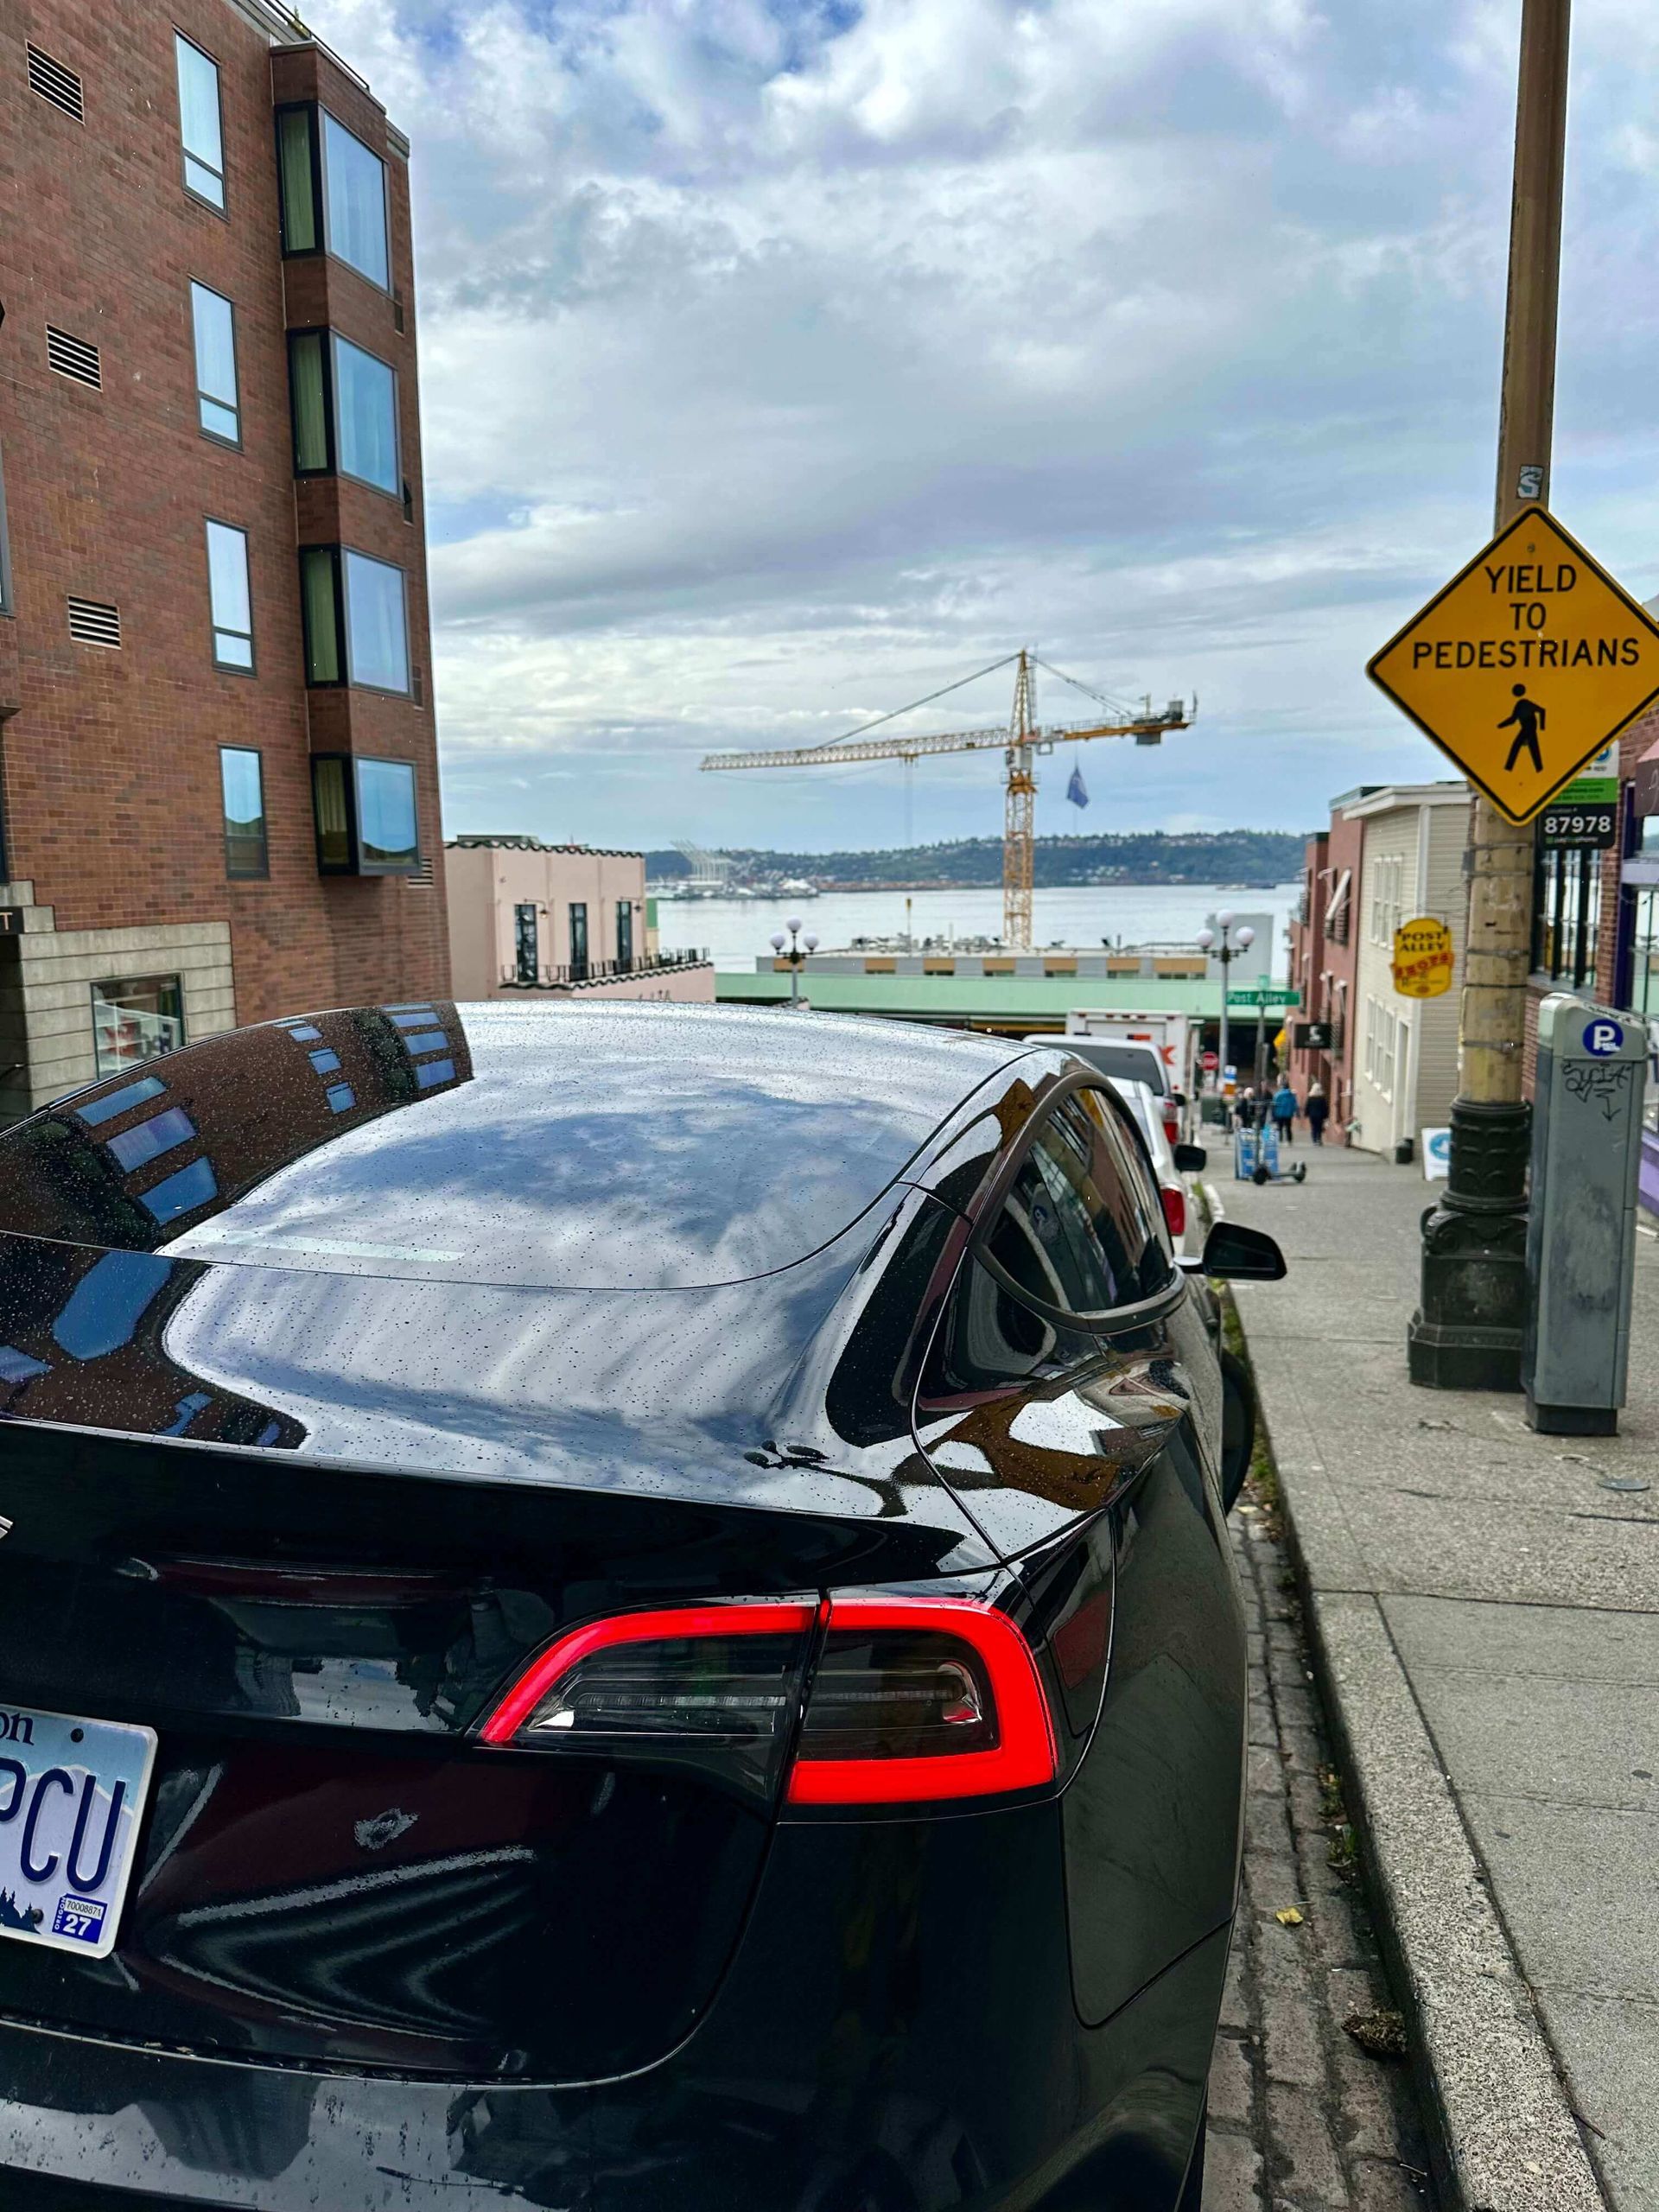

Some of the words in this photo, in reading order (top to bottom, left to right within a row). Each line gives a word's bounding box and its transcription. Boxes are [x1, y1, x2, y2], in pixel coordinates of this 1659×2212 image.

[1484, 564, 1577, 594] YIELD
[1510, 602, 1547, 631] TO
[1413, 638, 1640, 669] PEDESTRIANS
[1545, 816, 1611, 834] 87978
[1400, 942, 1446, 952] ALLEY
[1401, 931, 1445, 943] POST
[1227, 992, 1251, 1003] Post
[1255, 992, 1286, 1005] Alley
[1592, 1026, 1616, 1050] P
[54, 1897, 67, 1930] OREGON
[67, 1900, 101, 1916] 70008871
[63, 1914, 92, 1936] 27
